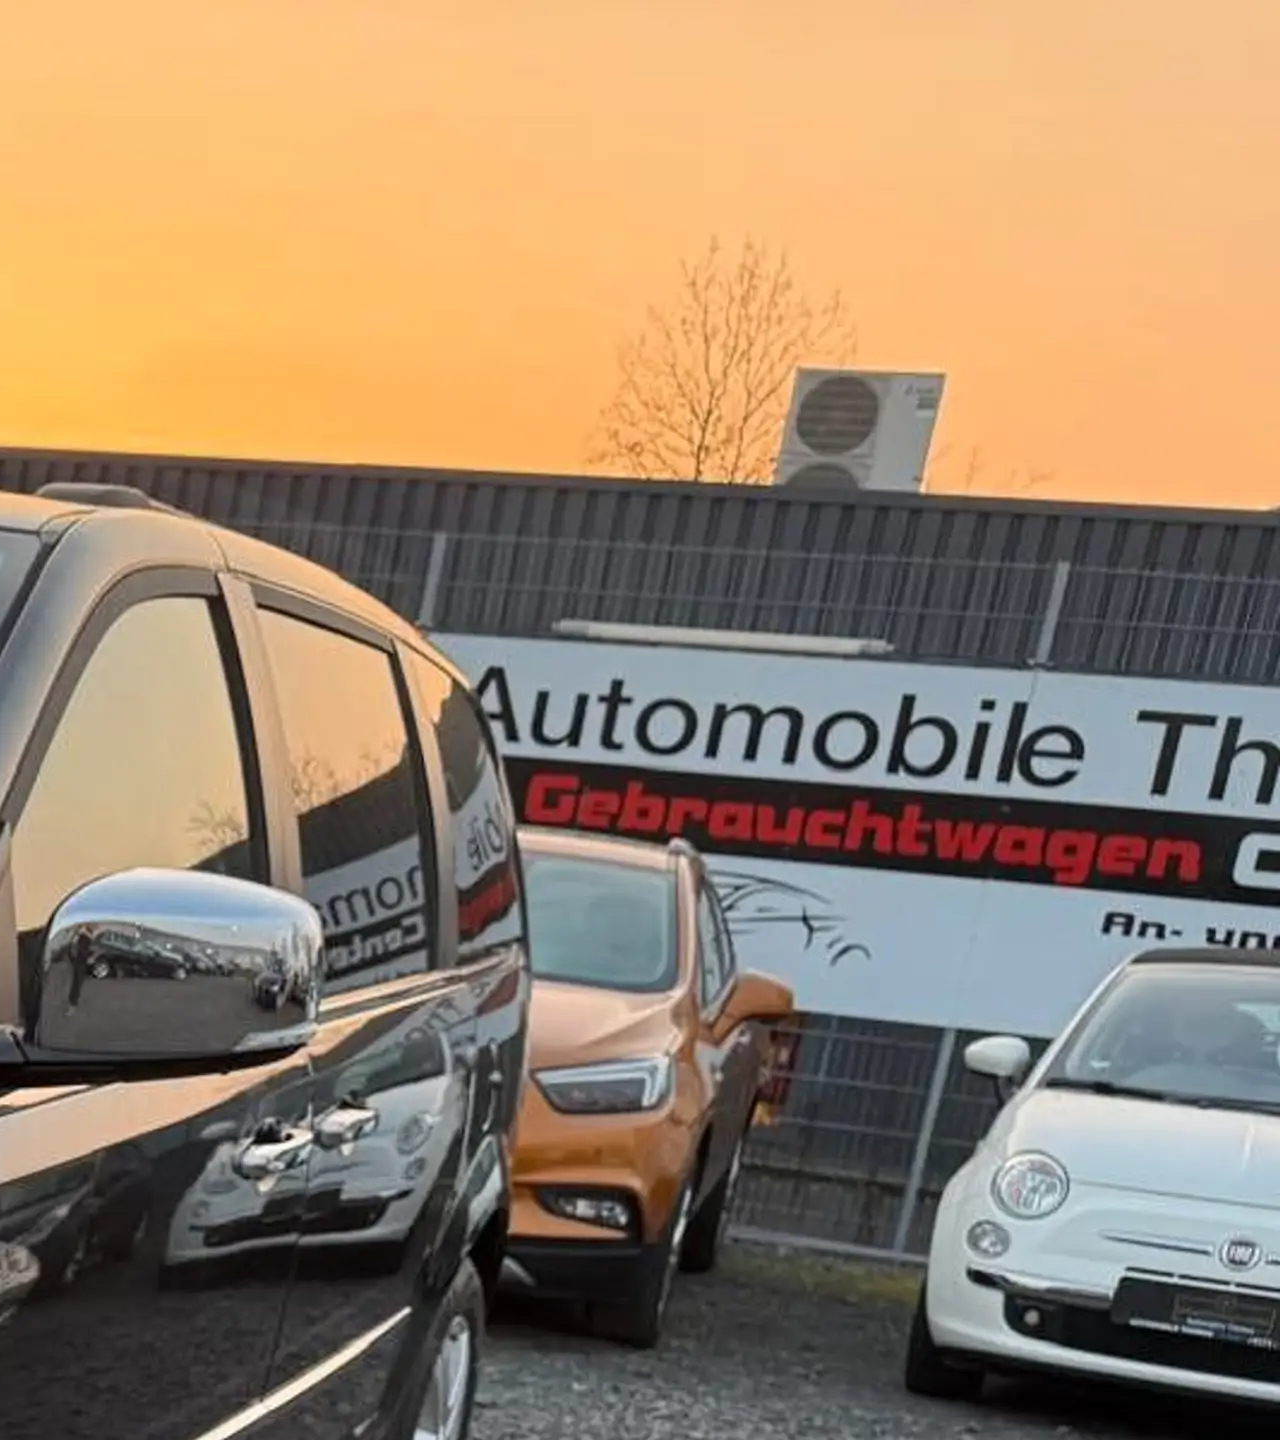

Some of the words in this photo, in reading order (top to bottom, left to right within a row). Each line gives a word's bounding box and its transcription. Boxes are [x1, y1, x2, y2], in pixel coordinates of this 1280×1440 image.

[477, 666, 1086, 787] Automobile
[1137, 708, 1280, 806] Th
[523, 772, 1202, 885] Gebrauchtwagen
[1101, 911, 1183, 940] An-
